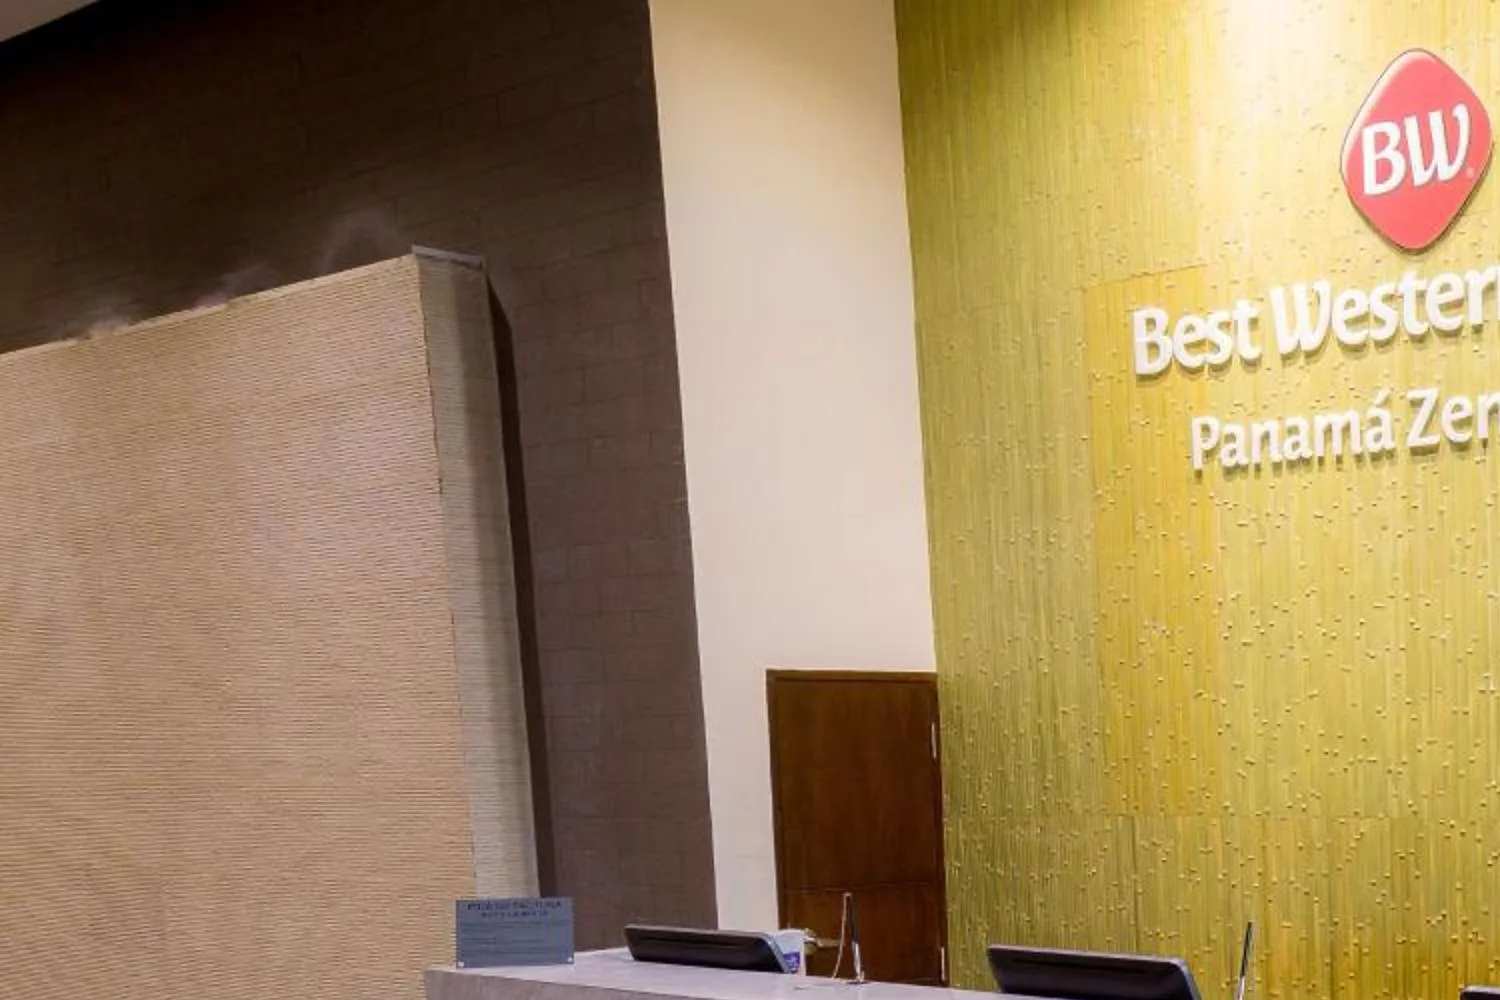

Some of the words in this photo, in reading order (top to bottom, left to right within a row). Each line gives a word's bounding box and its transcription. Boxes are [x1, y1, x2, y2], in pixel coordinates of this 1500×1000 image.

[1362, 103, 1471, 196] BW
[1133, 300, 1262, 376] Best
[1190, 389, 1396, 469] Panamá
